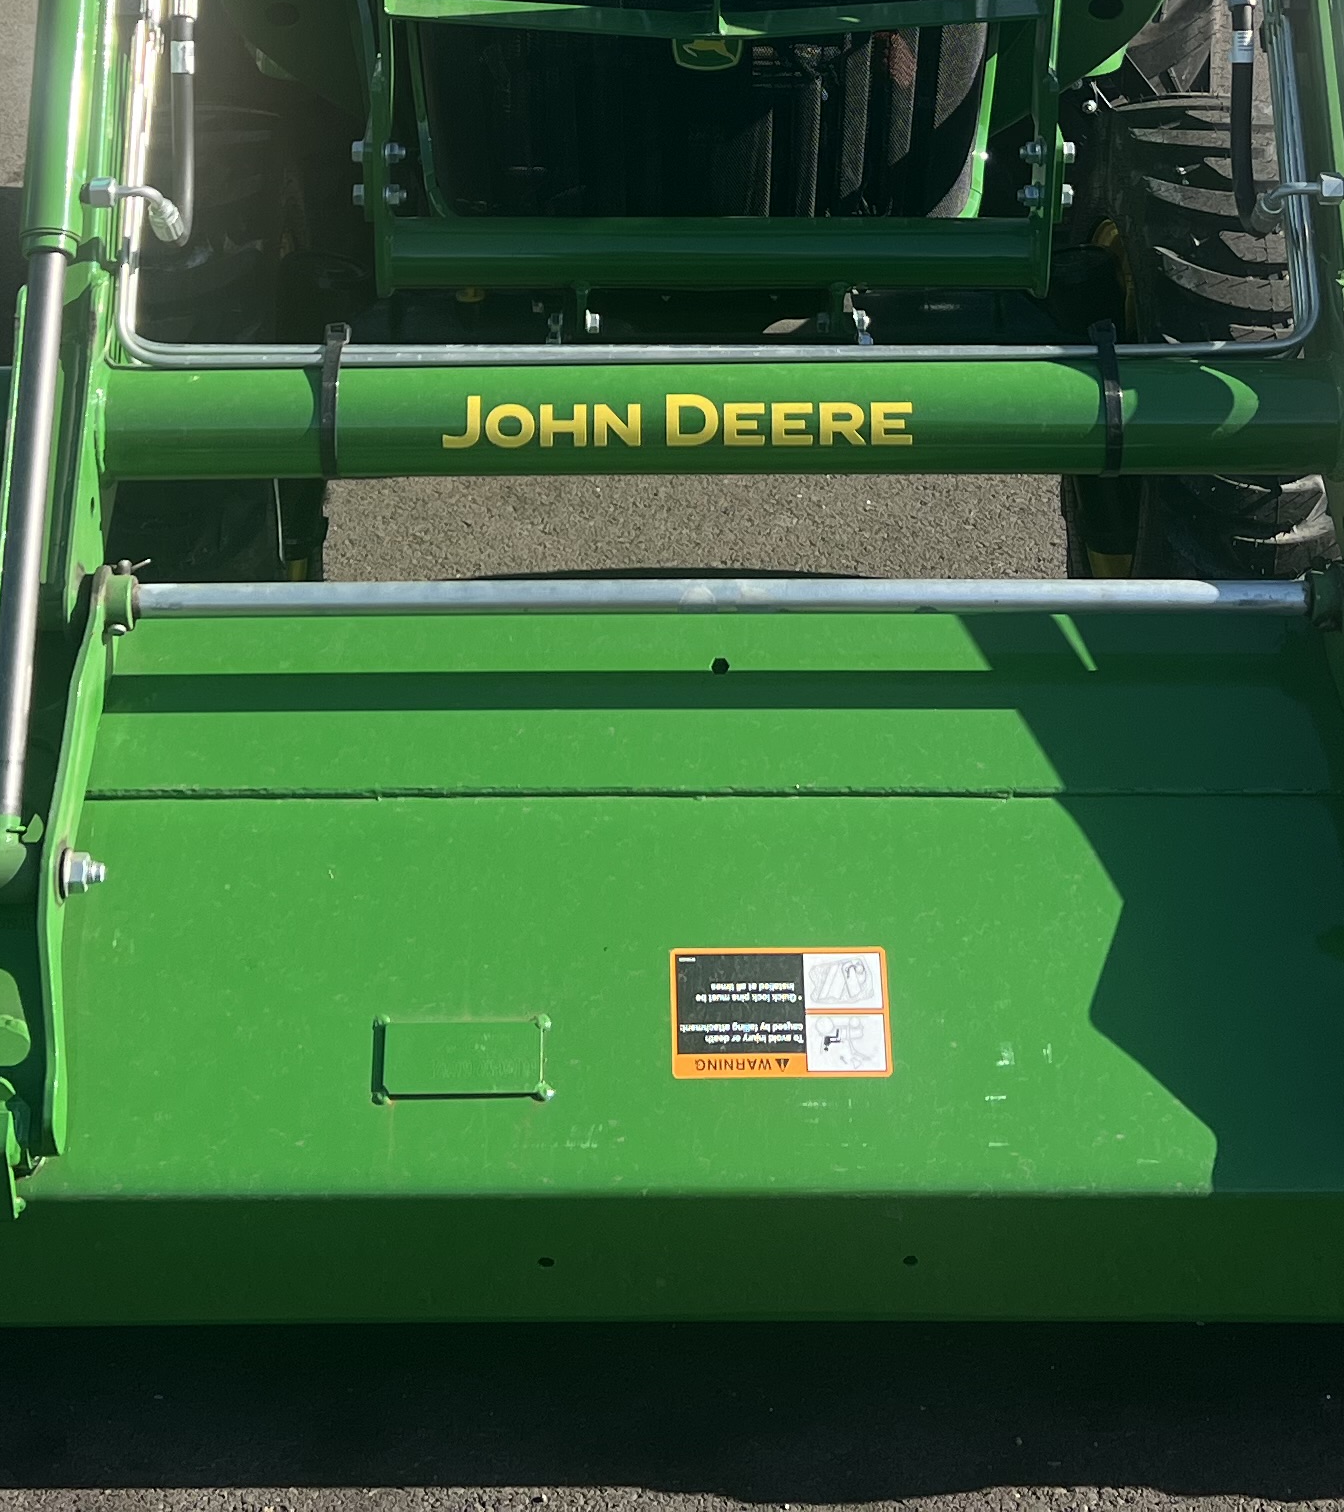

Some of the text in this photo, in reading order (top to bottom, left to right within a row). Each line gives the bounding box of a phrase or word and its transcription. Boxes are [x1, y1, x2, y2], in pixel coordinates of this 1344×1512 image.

[442, 393, 913, 449] JOHN DEERE
[736, 982, 746, 992] all
[748, 982, 757, 992] at
[759, 982, 794, 992] installed
[696, 993, 797, 1002] Quick lock pins must be
[732, 1022, 758, 1032] falling
[760, 1022, 771, 1032] by
[773, 1022, 803, 1032] caused
[705, 1032, 804, 1043] To avoid injury or death
[695, 1059, 771, 1071] WARNING
